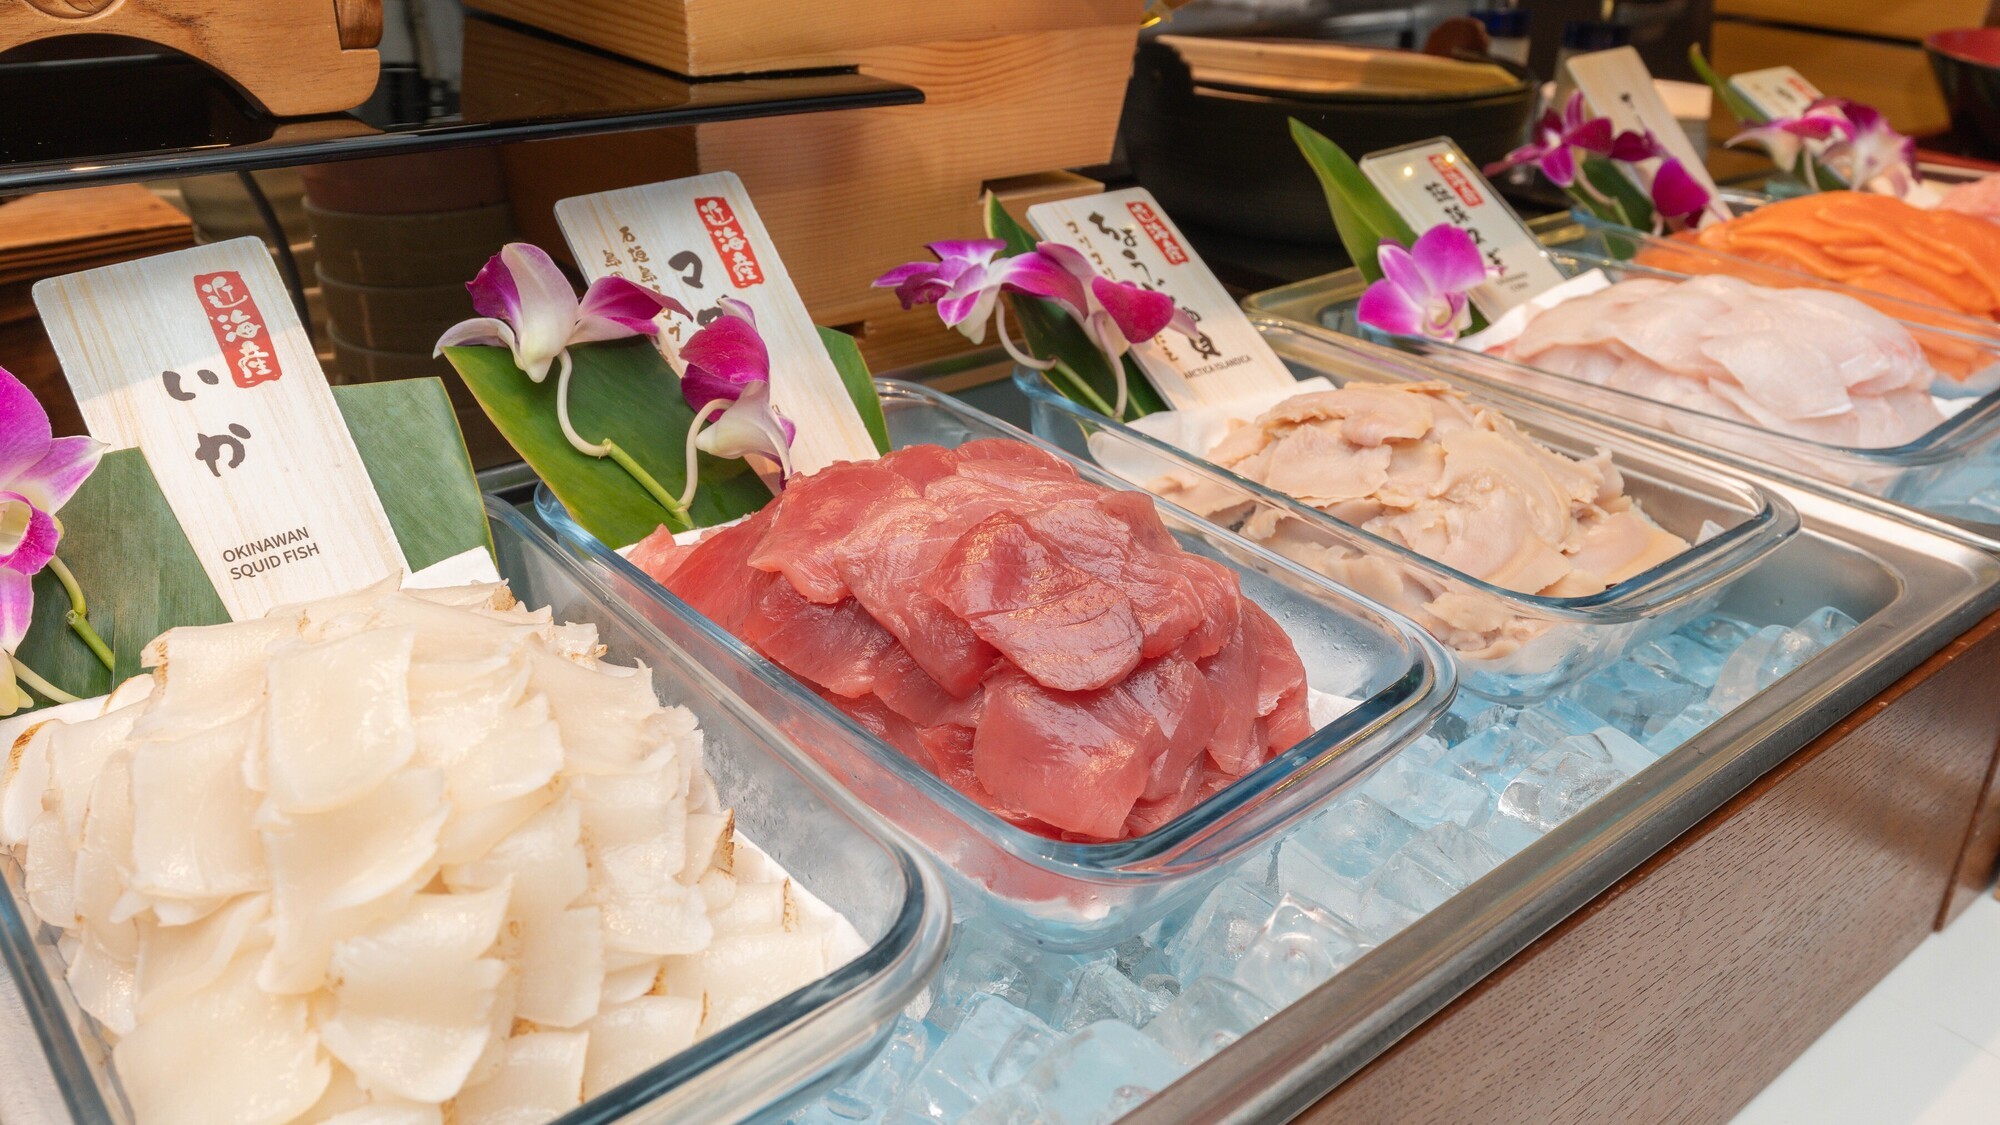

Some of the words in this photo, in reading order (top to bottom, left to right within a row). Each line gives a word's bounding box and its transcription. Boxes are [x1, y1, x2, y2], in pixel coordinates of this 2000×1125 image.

[700, 199, 758, 284] 近海産
[201, 275, 272, 378] 近海産
[162, 369, 251, 477] いか
[222, 526, 310, 563] OKINAWAN
[229, 555, 281, 580] SQUID
[283, 542, 320, 565] FISH
